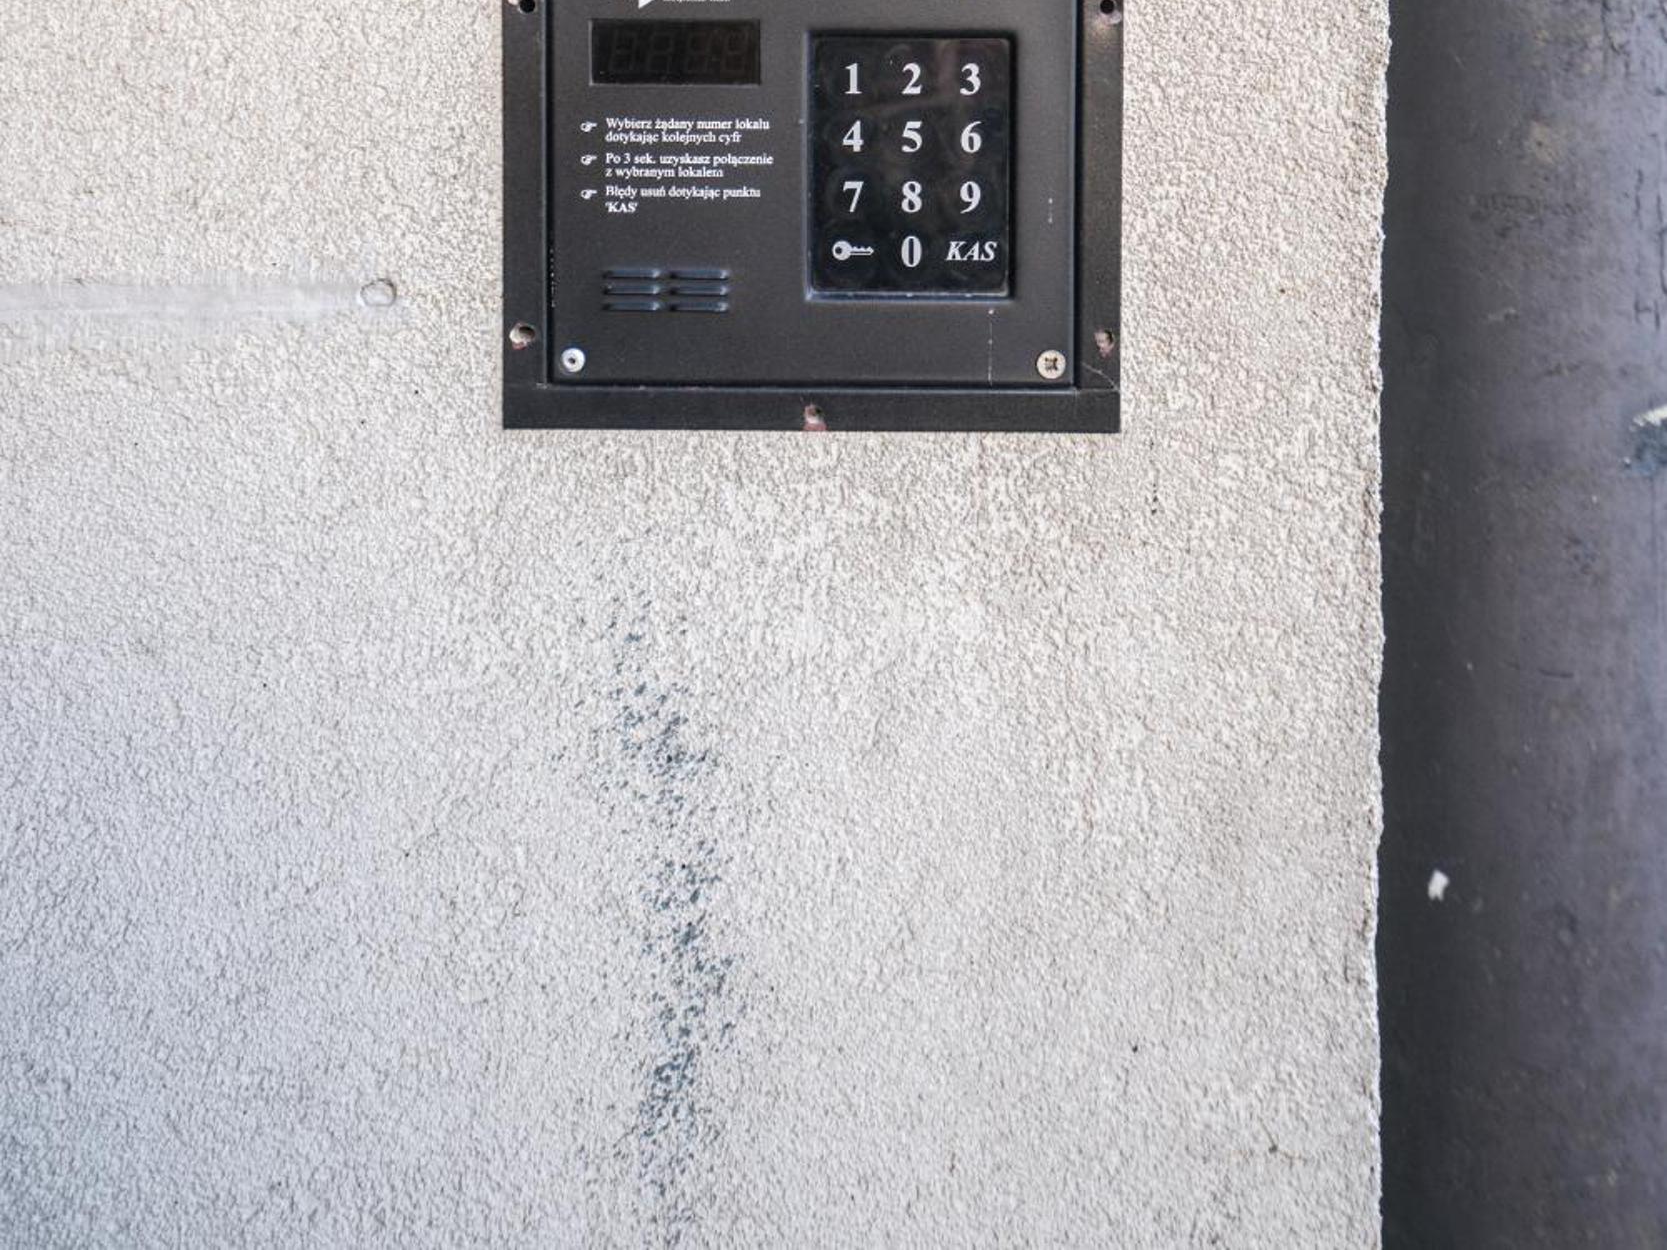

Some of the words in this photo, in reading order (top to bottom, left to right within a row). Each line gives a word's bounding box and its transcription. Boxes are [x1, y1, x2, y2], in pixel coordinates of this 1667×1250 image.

[845, 62, 863, 95] 1
[901, 62, 923, 95] 2
[959, 62, 982, 96] 3
[605, 117, 653, 131] Wybierz
[654, 117, 694, 132] żądany
[696, 120, 733, 130] numer
[734, 118, 770, 130] lokalu
[605, 131, 660, 144] dotykając
[661, 131, 717, 146] kolejnych
[718, 131, 742, 146] cyfr
[842, 119, 865, 153] 4
[901, 120, 923, 153] 5
[960, 120, 983, 153] 6
[605, 152, 621, 165] Po
[623, 152, 631, 165] 3
[633, 152, 657, 165] sek.
[659, 152, 712, 168] uzyskasz
[712, 152, 775, 168] połączenie
[605, 168, 613, 178] z
[614, 165, 676, 180] wybranym
[677, 166, 724, 178] lokalem
[605, 184, 638, 200] Błędy
[640, 185, 667, 198] usuń
[667, 185, 722, 201] dotykając
[722, 185, 761, 201] punktu
[842, 180, 865, 213] 7
[901, 180, 923, 214] 8
[959, 180, 982, 214] 9
[901, 235, 923, 268] 0
[946, 240, 998, 262] KAS
